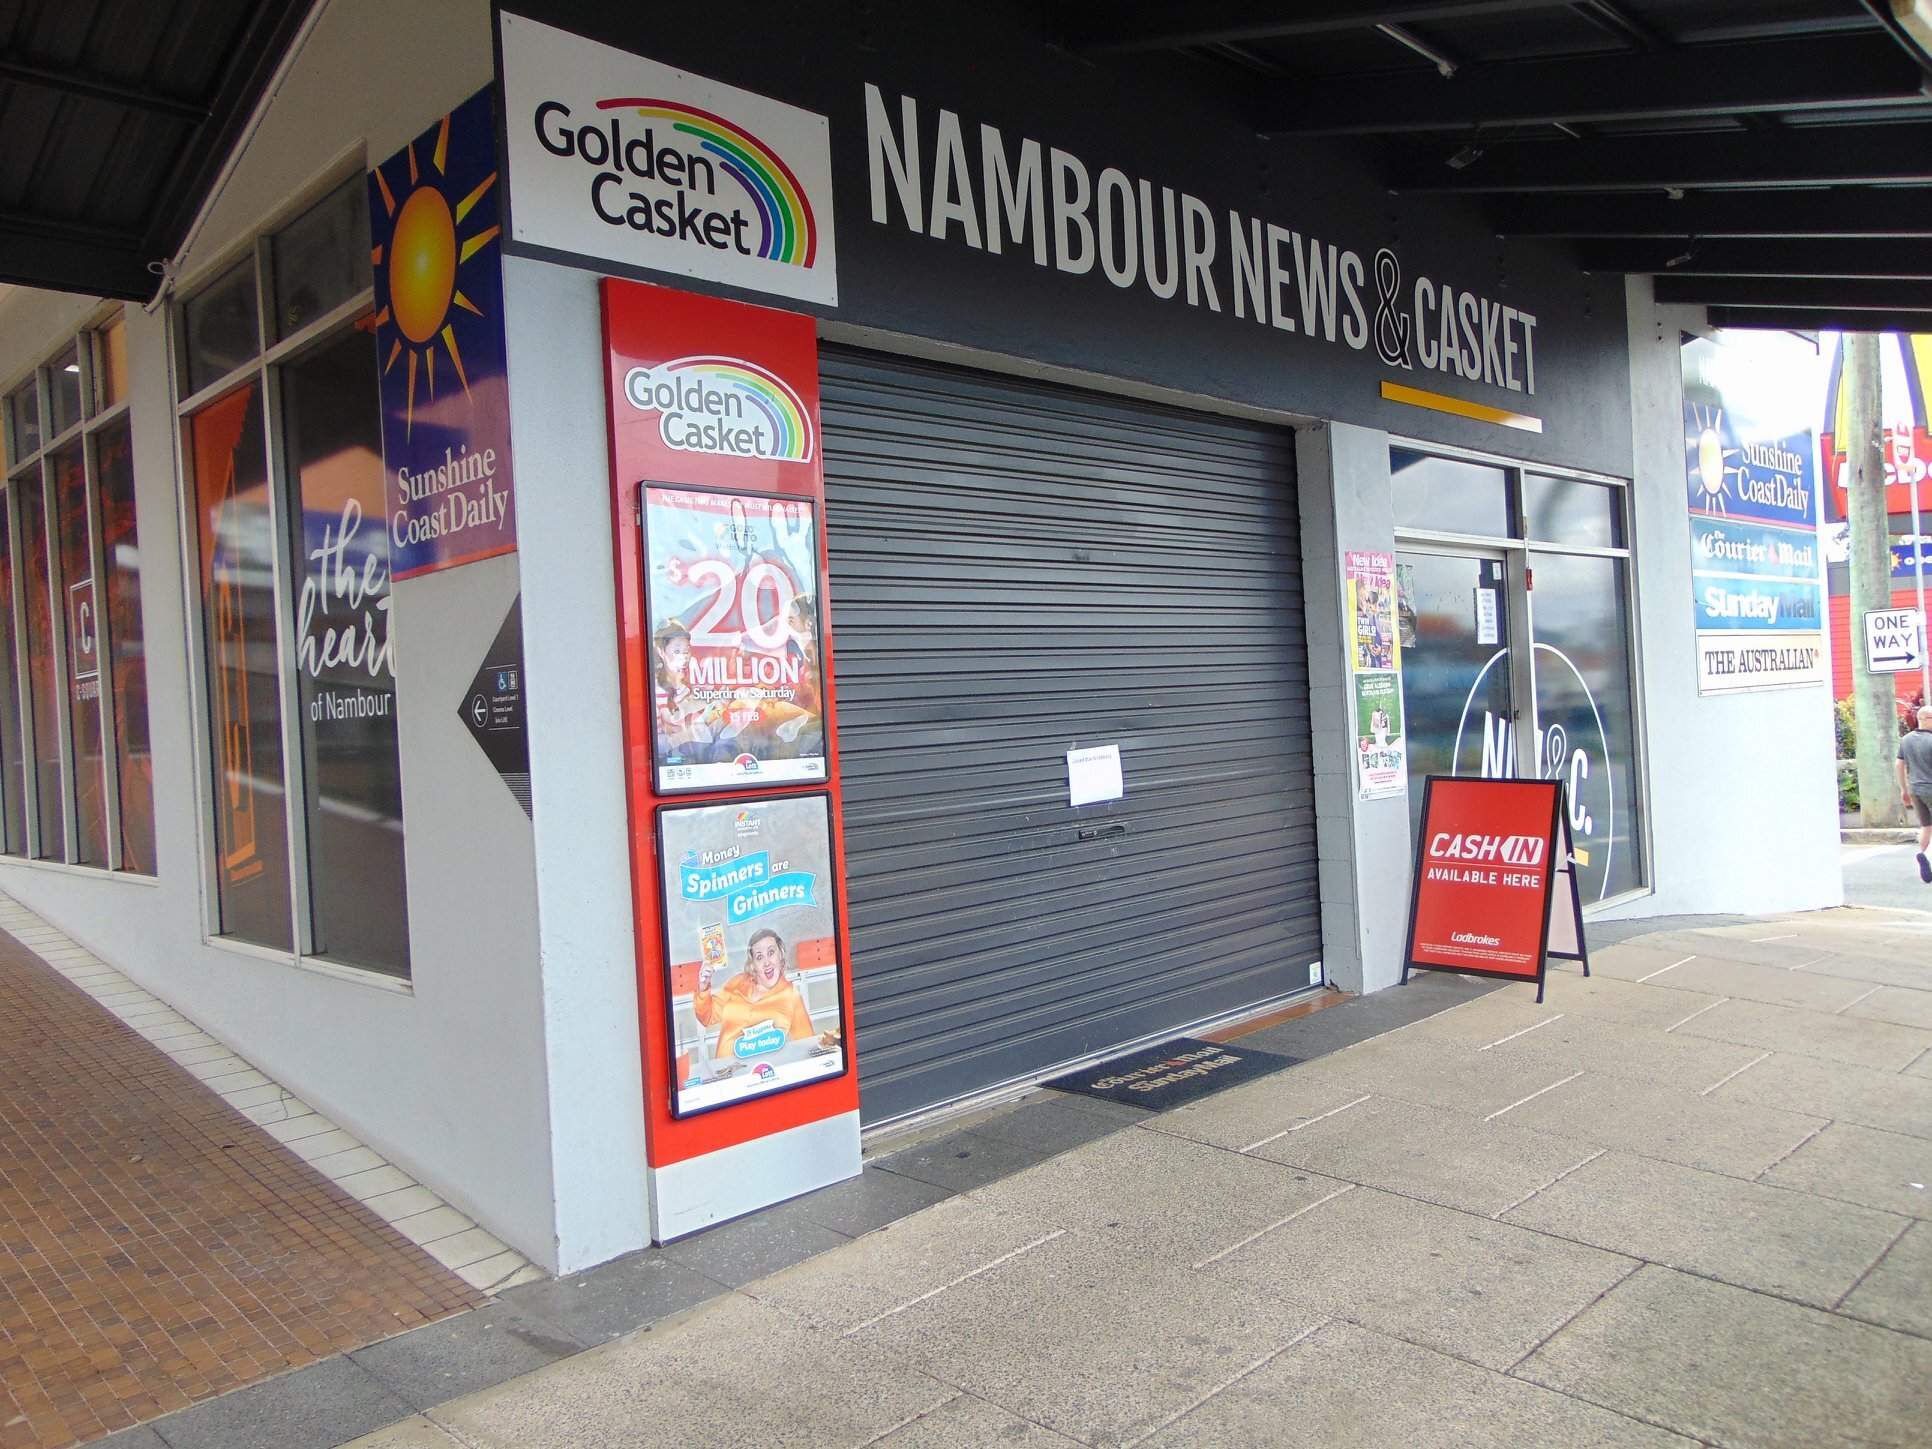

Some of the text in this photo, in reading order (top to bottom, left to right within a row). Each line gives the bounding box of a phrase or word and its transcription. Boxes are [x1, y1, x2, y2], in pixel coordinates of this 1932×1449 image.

[534, 101, 715, 195] Golden
[591, 172, 751, 255] Casket
[864, 82, 1537, 395] NAMBOUR NEWS & CASKET
[629, 371, 743, 418] Golden
[663, 412, 766, 455] Casket
[398, 444, 496, 505] Sunshine
[1742, 440, 1803, 475] Sunshine
[1737, 466, 1809, 518] Coast Daily
[393, 478, 508, 548] Coast Daily
[310, 498, 386, 615] the
[1700, 531, 1813, 567] Courier Mail
[81, 602, 91, 654] C
[297, 577, 397, 677] heart
[1874, 614, 1910, 630] ONE
[1873, 632, 1913, 649] WAY
[689, 656, 800, 685] MILLION
[1704, 648, 1814, 675] THE AUSTRALIAN
[311, 688, 391, 722] of Nambour
[693, 686, 796, 702] Superdraw Saturday
[742, 711, 760, 722] FEB
[702, 844, 740, 865] Money
[1429, 833, 1538, 863] CASH IN
[687, 860, 789, 898] Spinners are
[1427, 868, 1540, 888] AVAILABLE HERE
[733, 883, 805, 916] Grinners
[1451, 931, 1500, 946] Ladbrokes
[739, 1036, 781, 1051] Play today
